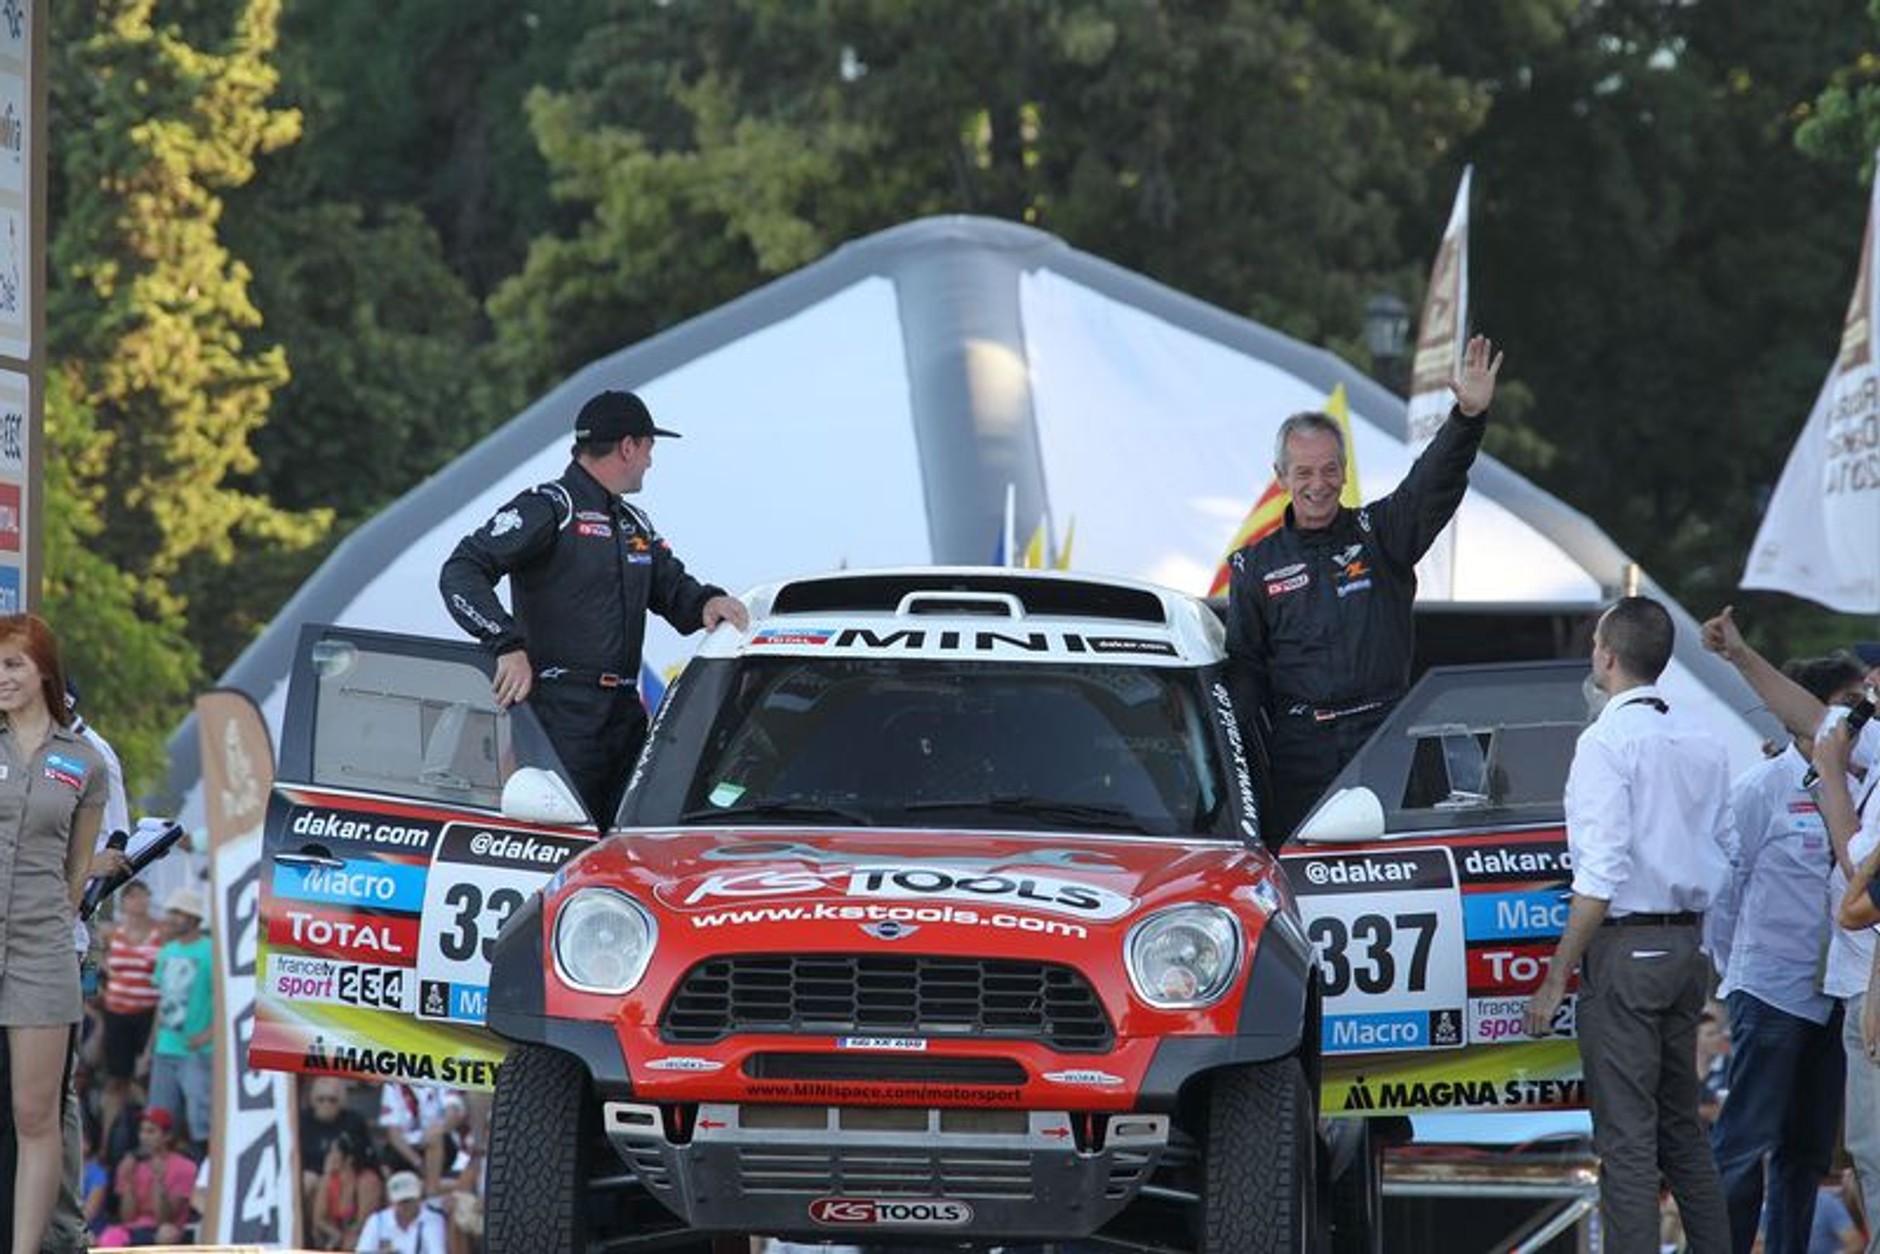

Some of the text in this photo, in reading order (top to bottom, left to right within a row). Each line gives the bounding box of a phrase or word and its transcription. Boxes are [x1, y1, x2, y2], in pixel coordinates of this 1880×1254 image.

[834, 629, 1086, 653] MINI
[293, 811, 430, 846] dakar.com
[470, 831, 569, 864] @dakar
[1464, 850, 1573, 875] dakar.c
[303, 867, 396, 899] Macro
[1305, 859, 1418, 885] @dakar
[861, 868, 1102, 909] TOOLS
[439, 882, 525, 962] 33
[690, 903, 1089, 939] www.kstools.com
[1497, 900, 1567, 930] Mac
[286, 911, 403, 953] TOTAL
[277, 955, 336, 977] francetv
[1308, 911, 1438, 997] 337
[277, 975, 333, 999] sport
[1478, 998, 1527, 1017] franc
[1332, 1020, 1419, 1045] Macro
[1478, 1015, 1522, 1041] spo
[333, 1047, 504, 1086] MAGNA STEY
[746, 1082, 1022, 1101] www.MINIspace.com/motorsport
[1379, 1078, 1586, 1109] MAGNA STEY
[819, 1201, 962, 1221] KS TOOLS
